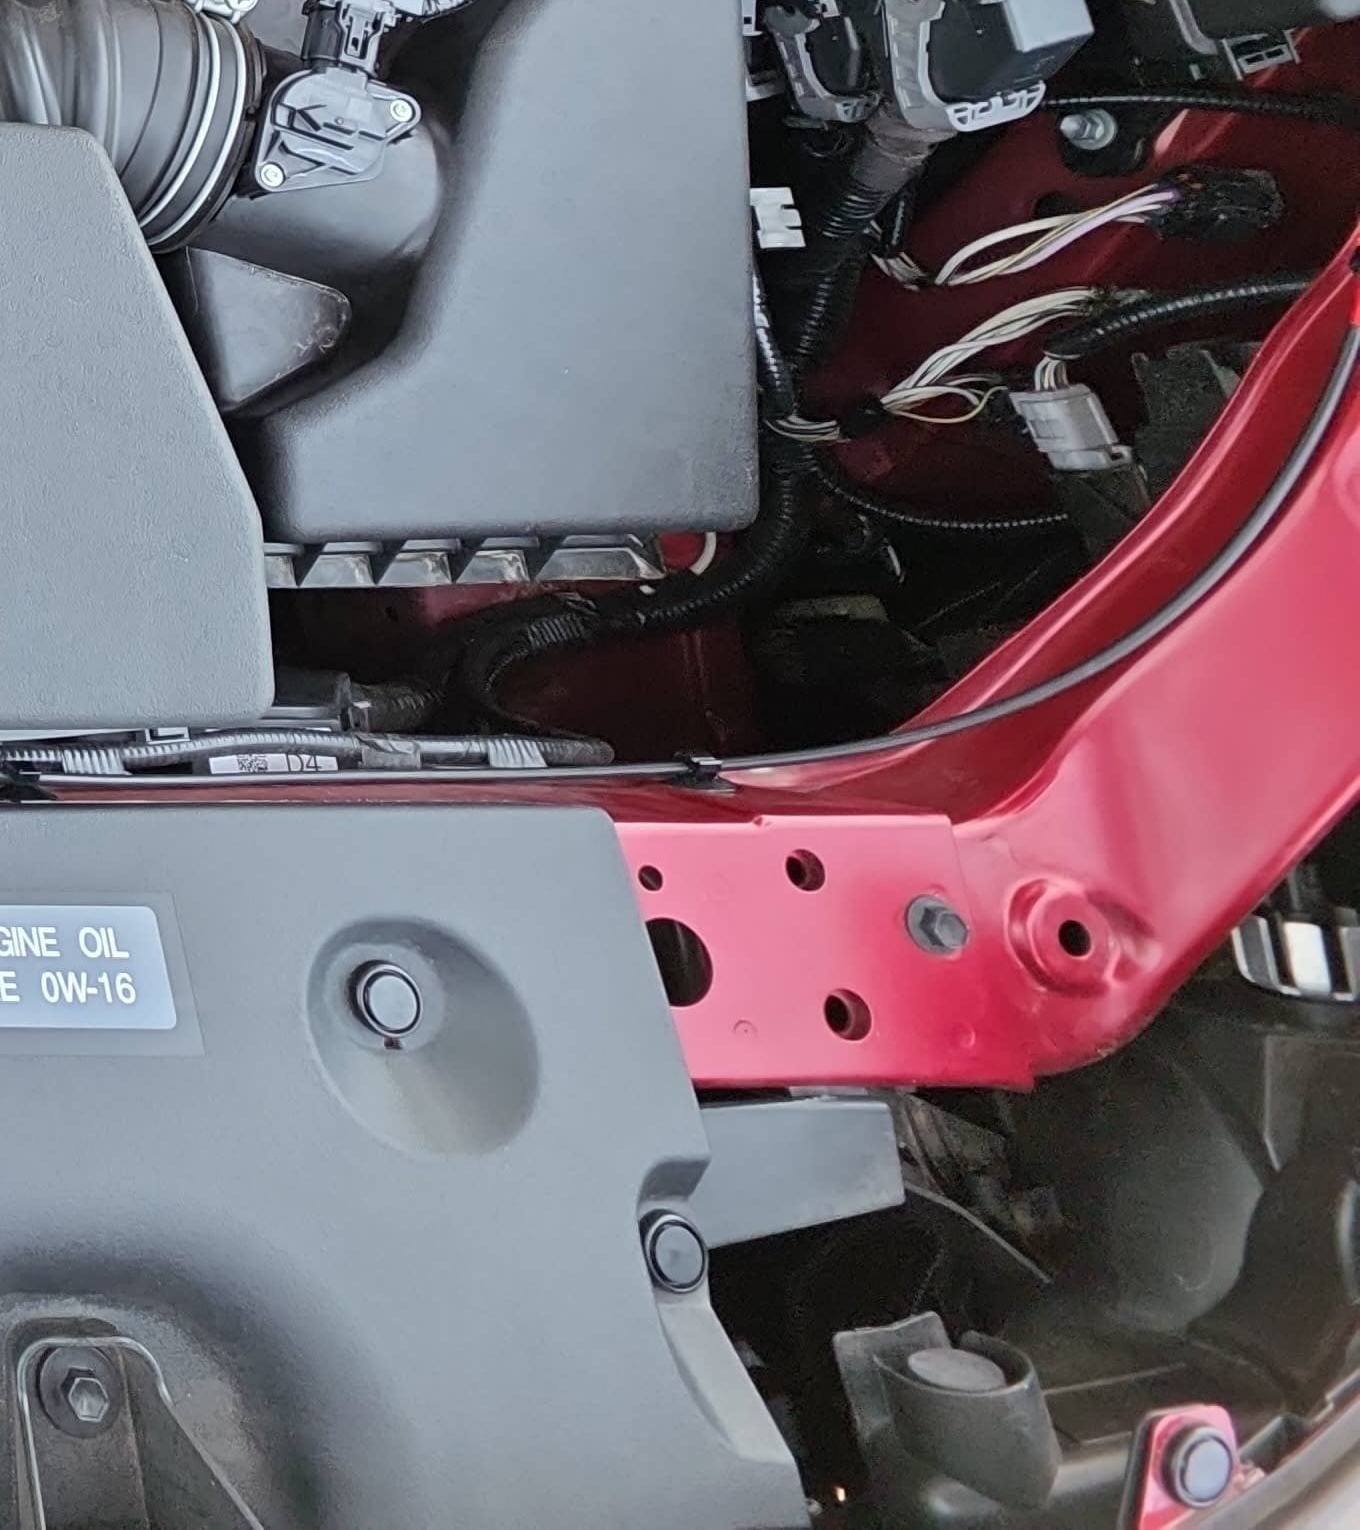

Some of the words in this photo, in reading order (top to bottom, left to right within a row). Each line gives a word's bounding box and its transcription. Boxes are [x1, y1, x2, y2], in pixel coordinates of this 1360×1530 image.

[285, 754, 322, 772] D4
[78, 926, 130, 959] OIL
[40, 972, 137, 1005] 0W-16
